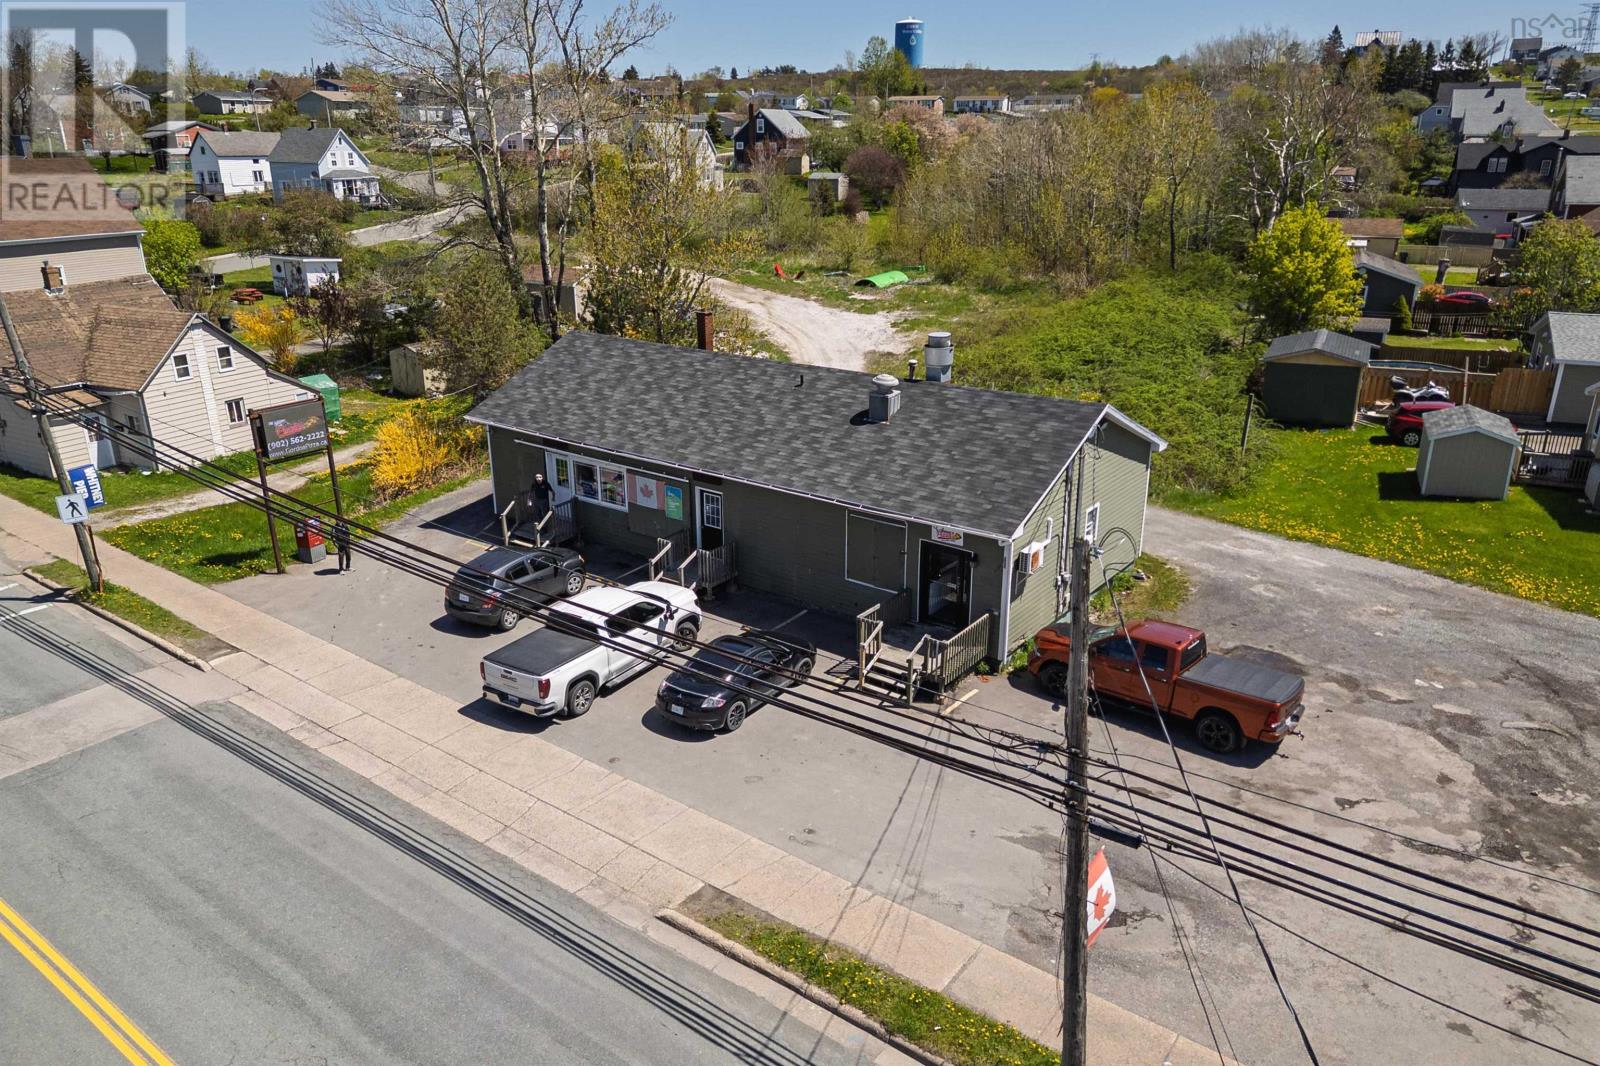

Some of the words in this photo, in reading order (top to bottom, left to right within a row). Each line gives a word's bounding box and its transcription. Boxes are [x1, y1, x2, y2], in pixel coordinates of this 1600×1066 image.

[267, 439, 289, 451] (902)
[290, 431, 325, 445] 562-2222
[83, 466, 104, 504] WHITNEY
